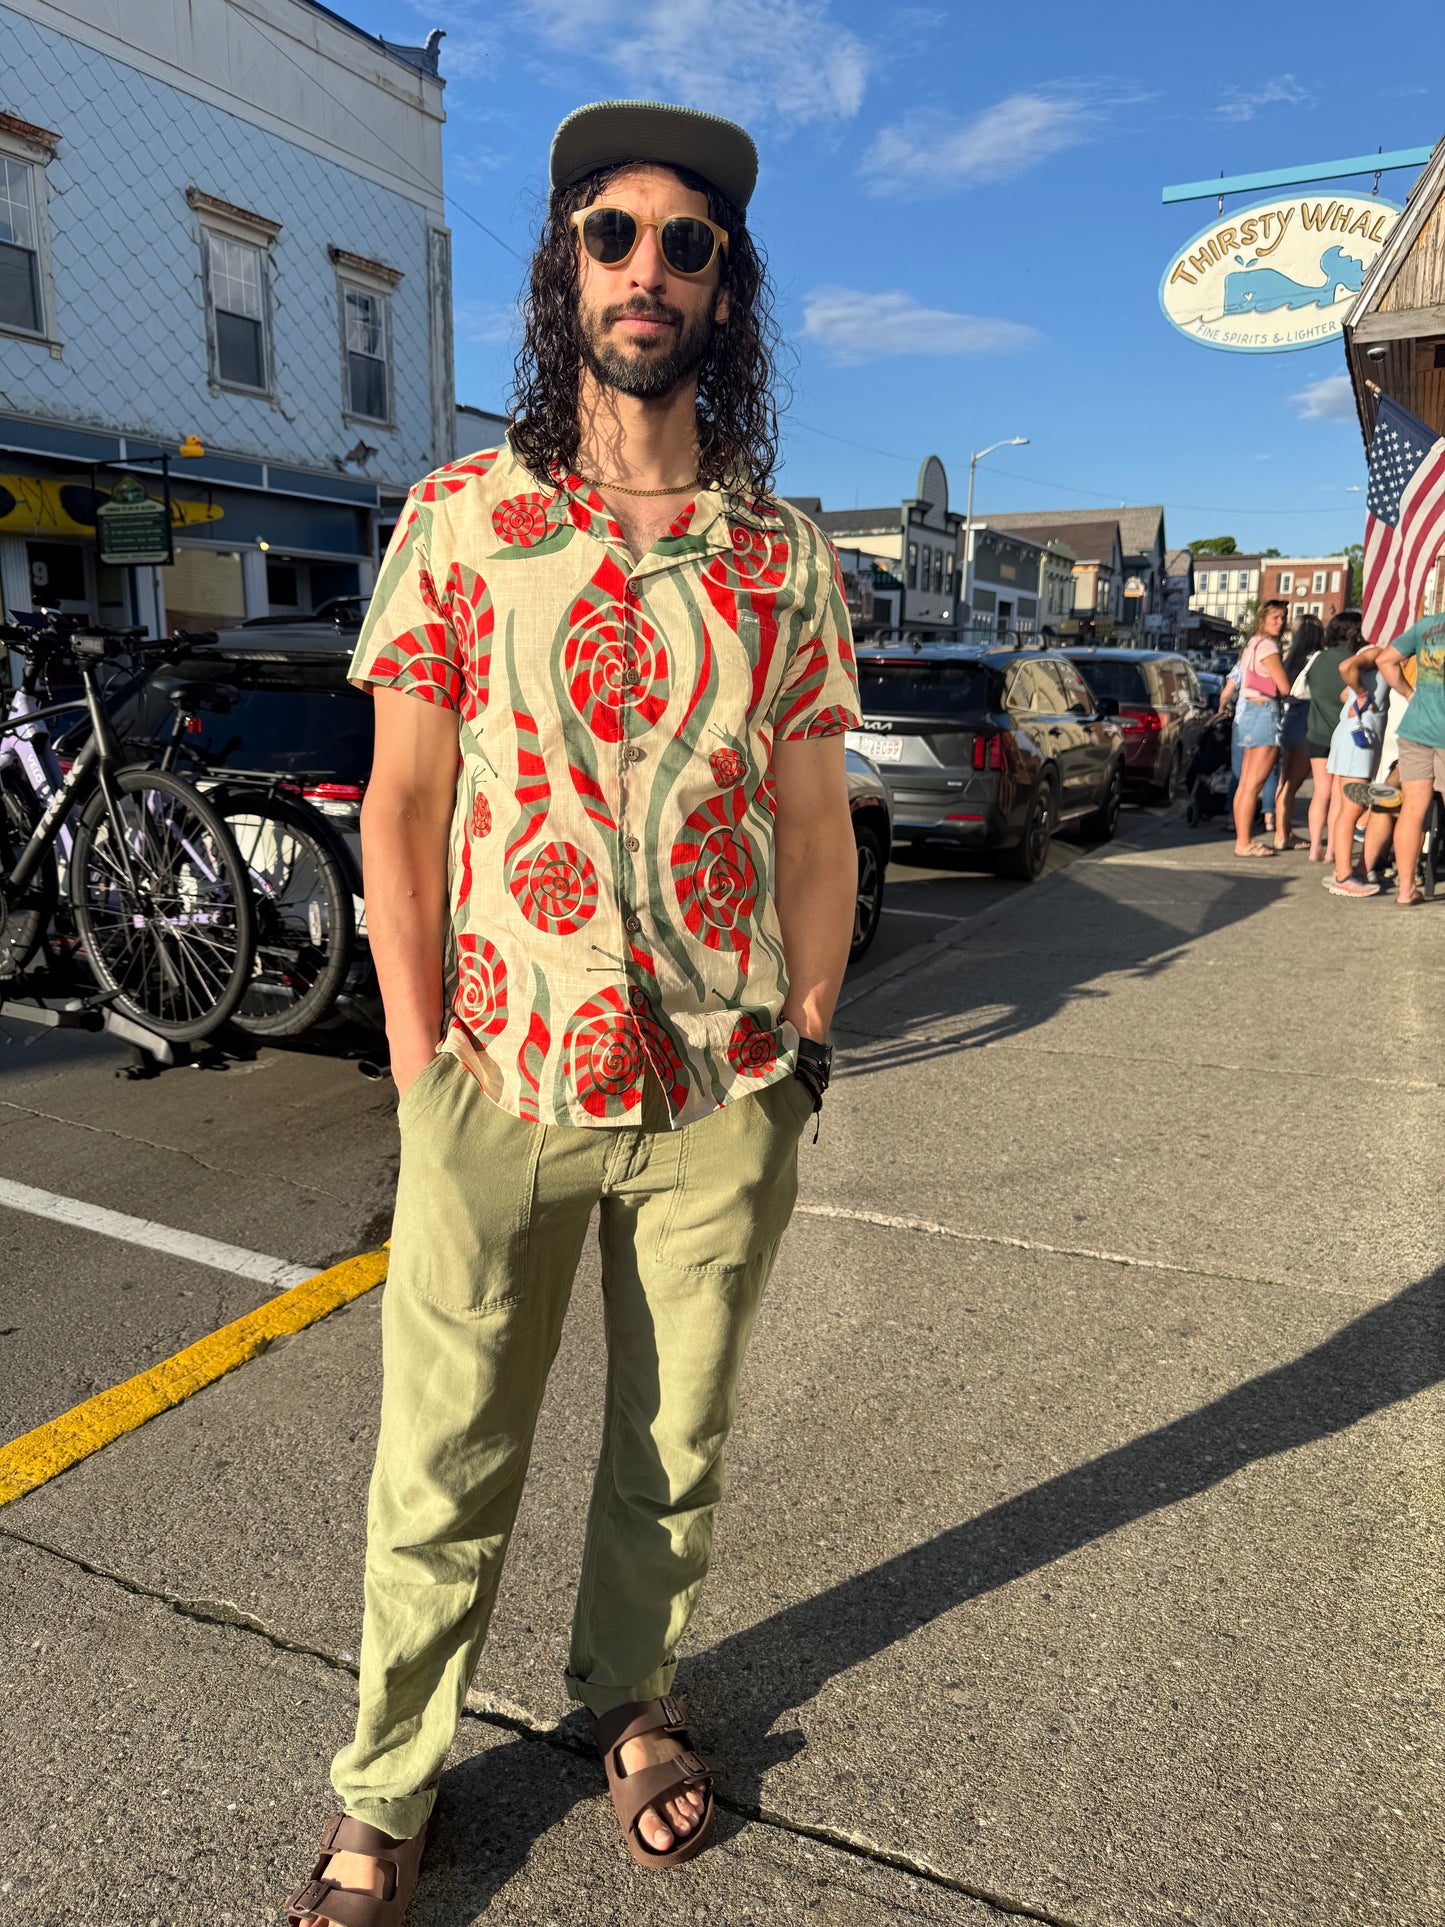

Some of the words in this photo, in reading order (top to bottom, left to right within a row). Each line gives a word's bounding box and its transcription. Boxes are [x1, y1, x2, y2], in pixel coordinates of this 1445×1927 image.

[1170, 207, 1295, 285] THIRSTY
[1301, 201, 1386, 243] WHAL
[1196, 324, 1220, 340] FINE
[1222, 331, 1267, 344] SPIRITS
[1272, 333, 1284, 343] &
[1287, 320, 1337, 342] LIGHTER
[32, 561, 49, 586] 9
[864, 721, 893, 730] KIA
